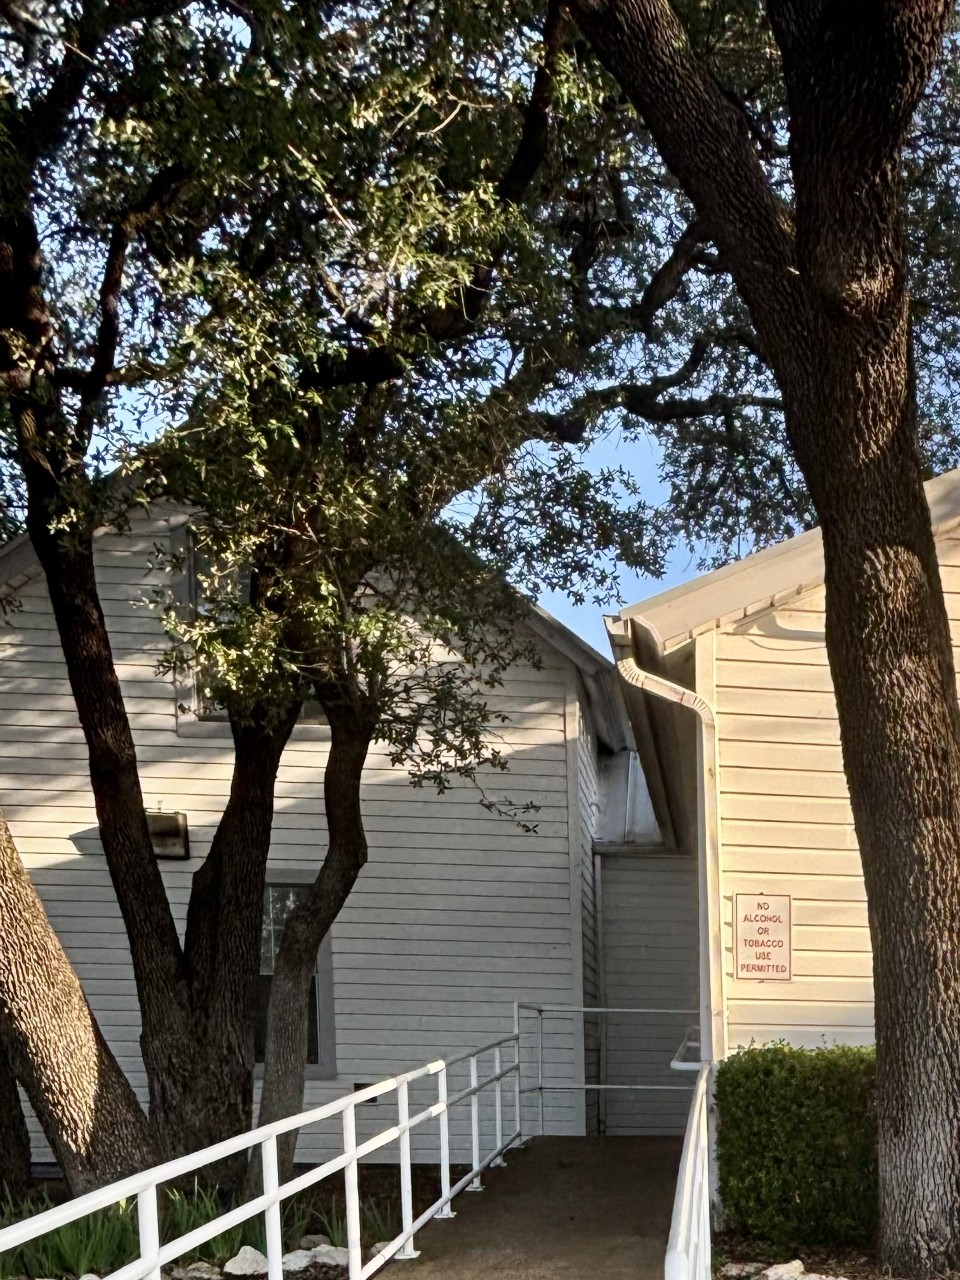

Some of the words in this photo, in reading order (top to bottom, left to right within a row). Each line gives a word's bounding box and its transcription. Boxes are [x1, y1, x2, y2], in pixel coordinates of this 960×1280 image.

[757, 902, 770, 910] NO
[742, 914, 783, 923] ALCOHOL
[757, 927, 769, 935] OR
[743, 939, 784, 948] TOBACCO
[755, 951, 772, 960] USE
[740, 963, 787, 973] PERMITTED
